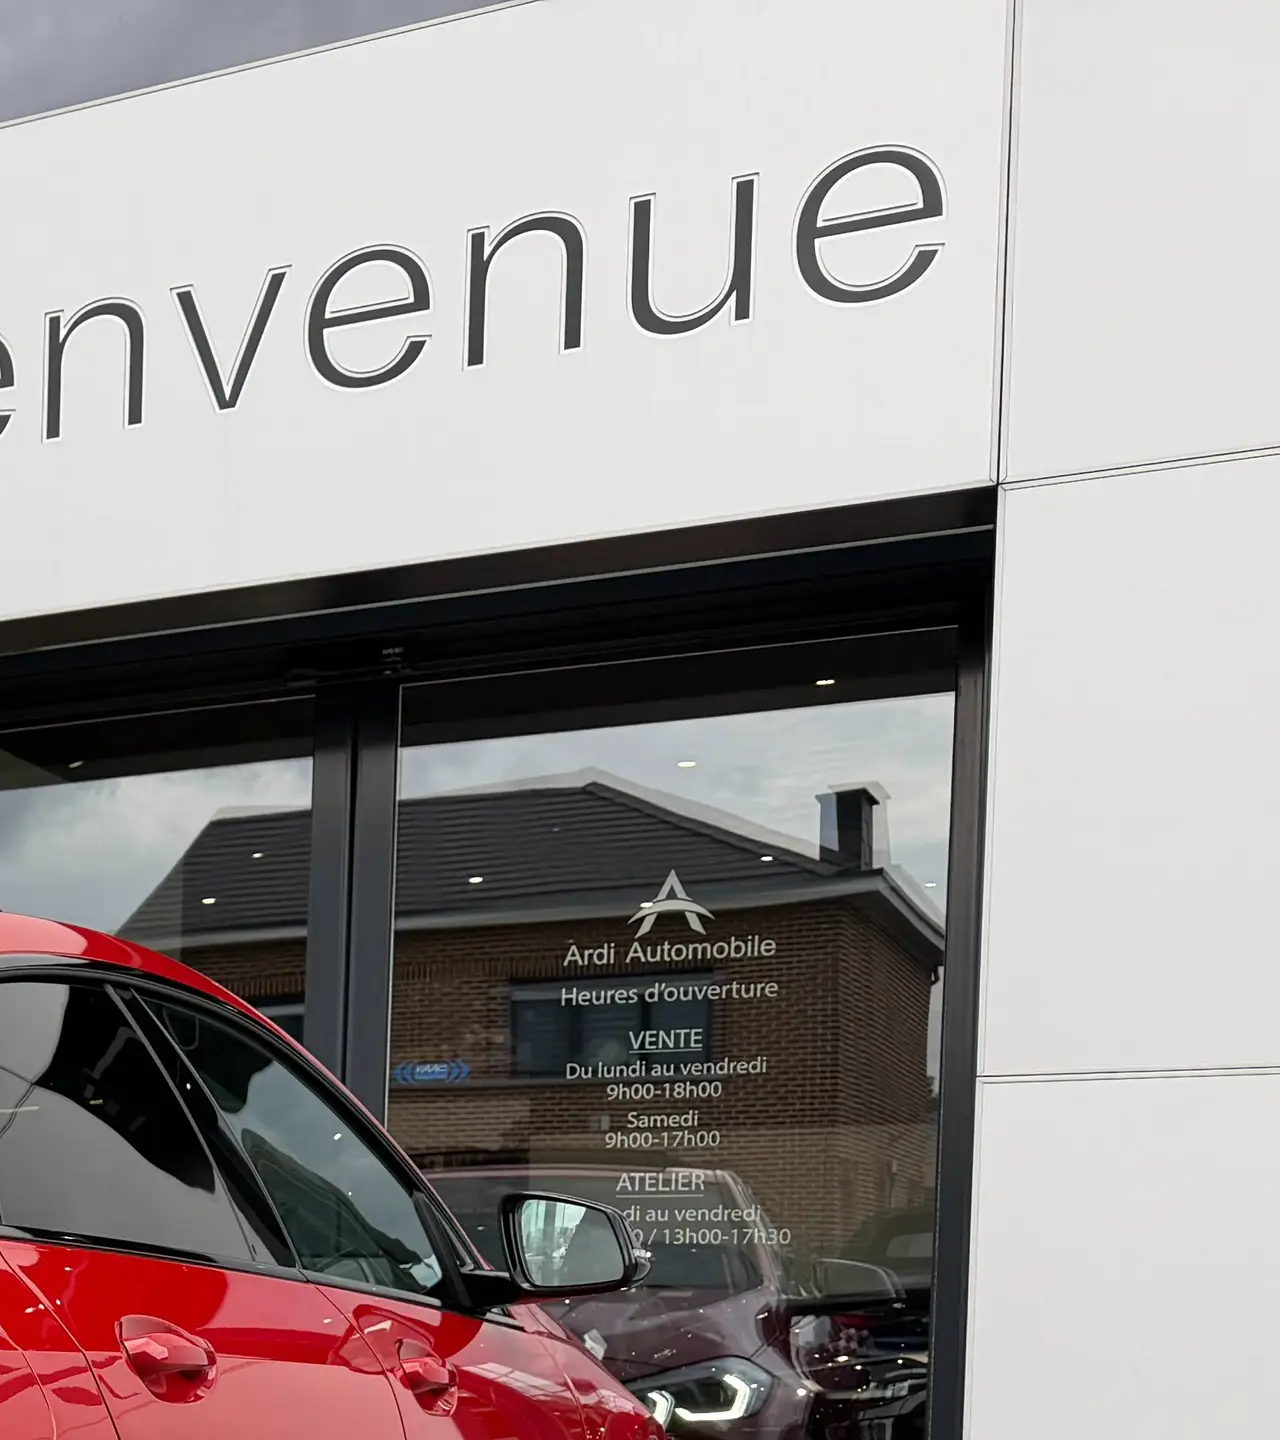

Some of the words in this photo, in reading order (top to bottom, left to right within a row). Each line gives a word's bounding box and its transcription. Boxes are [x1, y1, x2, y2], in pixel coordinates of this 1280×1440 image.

[563, 942, 616, 967] Ardi
[625, 935, 777, 964] Automobile
[560, 987, 639, 1007] Heures
[644, 981, 779, 1003] d'ouverture
[628, 1028, 704, 1051] VENTE
[565, 1062, 592, 1080] Du
[597, 1060, 646, 1078] lundi
[651, 1062, 674, 1077] au
[680, 1056, 767, 1076] vendredi
[606, 1081, 722, 1100] 9h00-18h00
[626, 1110, 699, 1128] Samedi
[604, 1130, 721, 1148] 9h00-17h00
[615, 1171, 705, 1192] ATELIER
[645, 1208, 669, 1222] au
[674, 1204, 761, 1222] vendredi
[663, 1227, 791, 1245] 13h00-17h30
